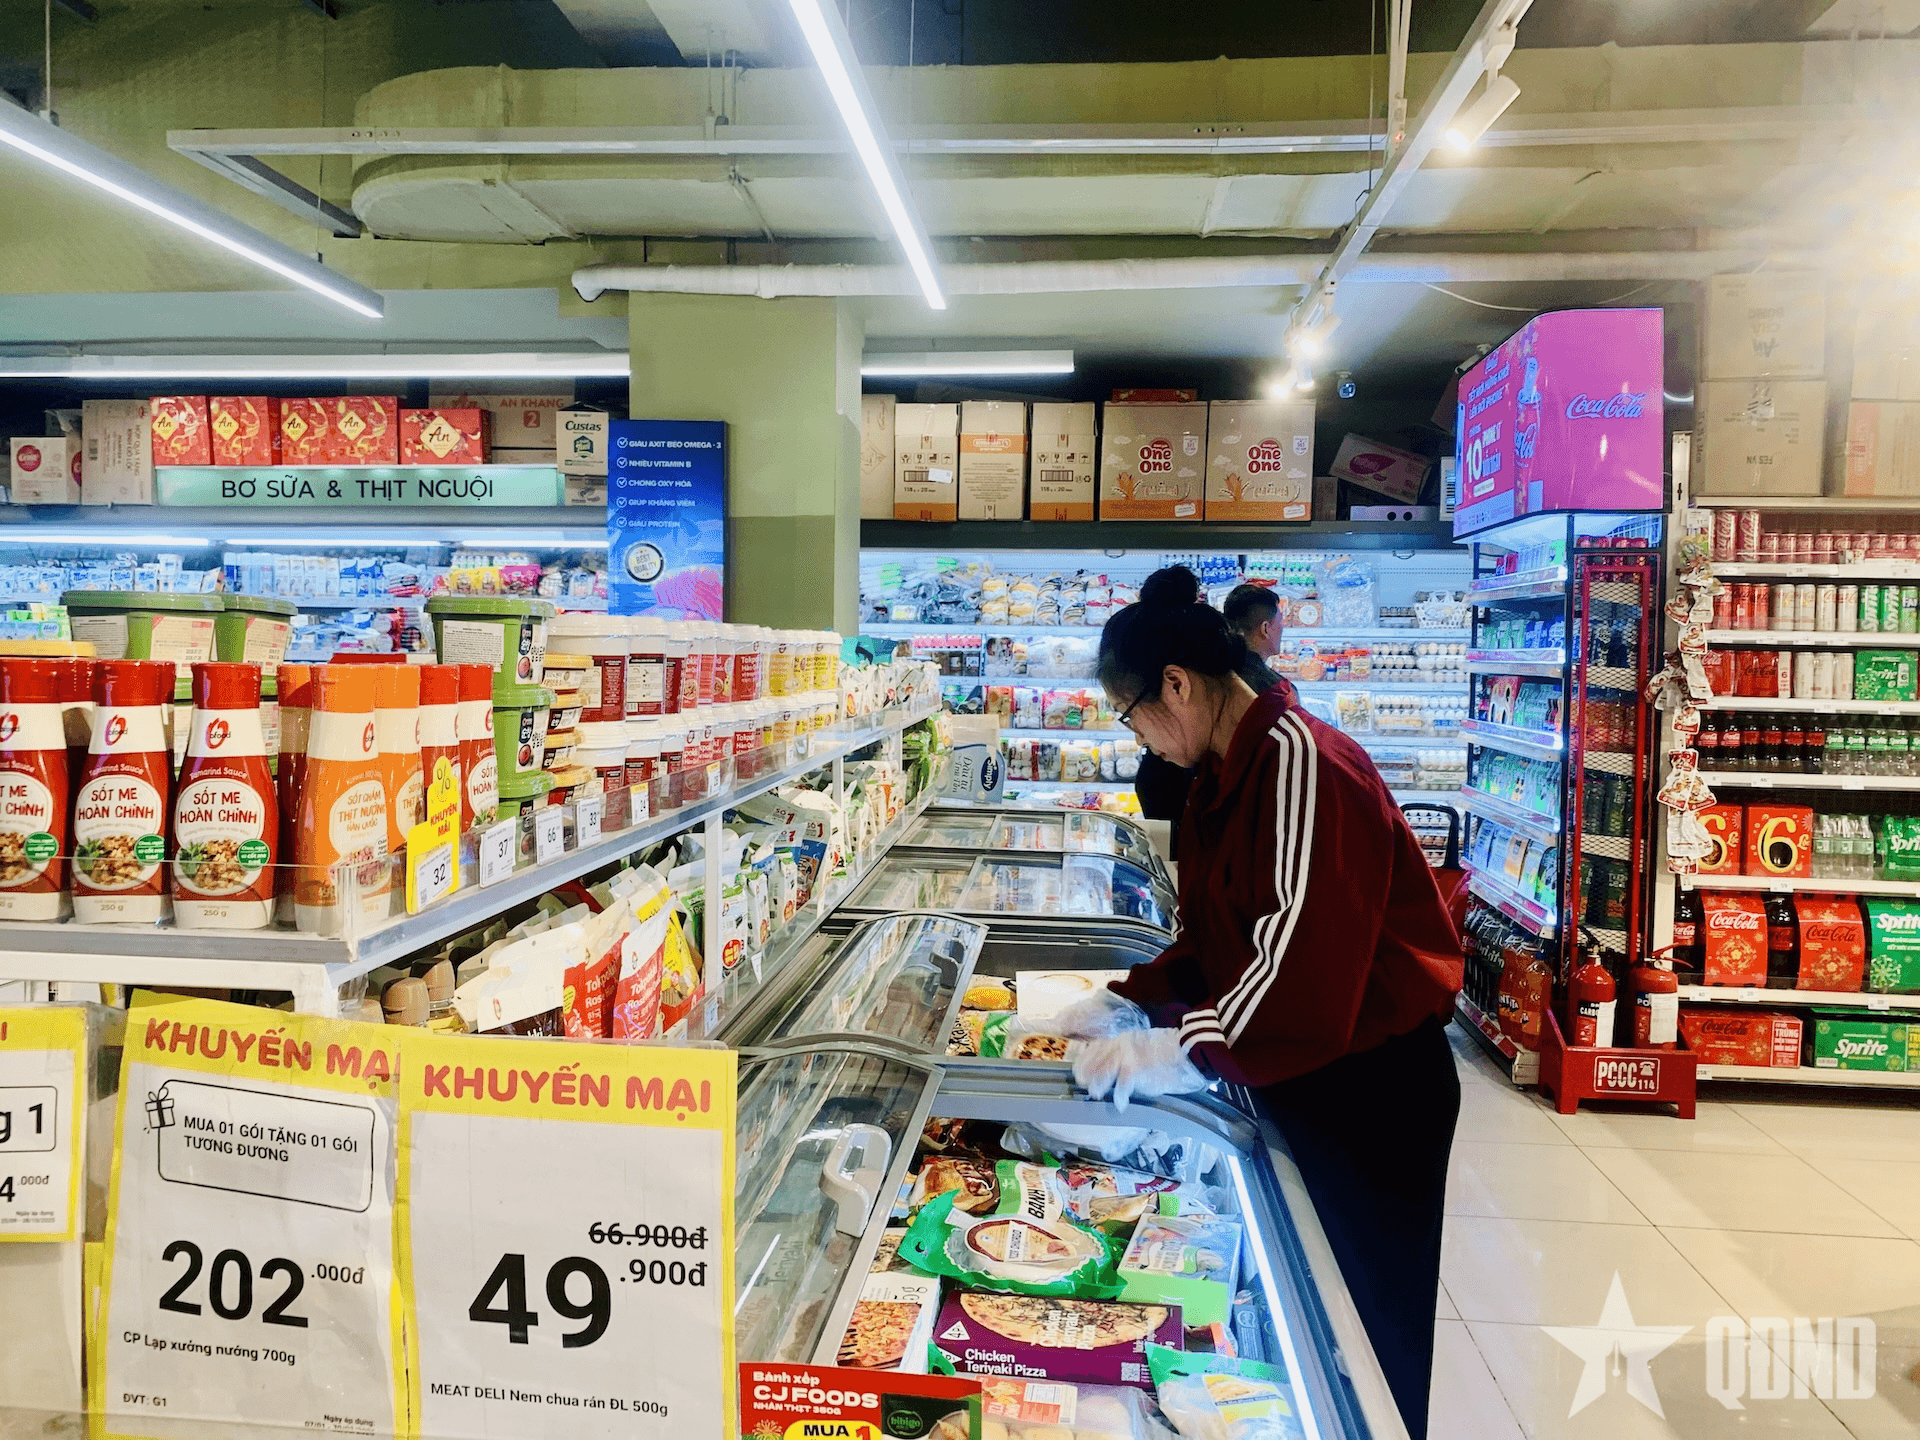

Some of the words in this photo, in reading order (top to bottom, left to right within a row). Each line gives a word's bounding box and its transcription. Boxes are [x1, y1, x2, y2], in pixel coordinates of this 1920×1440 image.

[500, 399, 519, 408] AN
[522, 399, 564, 408] KHANG
[565, 420, 602, 432] Custas
[1140, 447, 1172, 460] One
[1248, 446, 1282, 460] One
[1466, 438, 1482, 484] 10
[1140, 460, 1172, 474] One
[1248, 460, 1282, 474] One
[222, 478, 256, 498] BƠ
[266, 475, 314, 498] SỮA
[326, 480, 342, 498] &
[356, 480, 408, 501] THỊT
[419, 476, 493, 501] NGUỘI
[636, 554, 650, 564] BEST
[634, 562, 657, 574] QUALITY
[120, 762, 144, 775] Sauce
[223, 766, 248, 779] Sauce
[984, 759, 998, 789] Simply
[9, 786, 28, 798] ME
[118, 788, 138, 800] ME
[221, 792, 241, 804] ME
[78, 804, 110, 820] HOÀN
[180, 807, 212, 824] HOÀN
[589, 812, 597, 826] 33
[548, 828, 556, 843] 66
[817, 822, 823, 838] 1
[498, 839, 509, 858] 37
[1758, 816, 1798, 874] 6
[433, 864, 446, 886] 32
[101, 904, 115, 912] 250
[118, 904, 124, 912] g
[204, 909, 218, 917] 250
[1710, 912, 1760, 930] Coca-Cola
[144, 1018, 312, 1071] KHUYẾN
[1834, 1038, 1888, 1058] Sprite
[1598, 1061, 1638, 1088] PCCC
[1638, 1079, 1655, 1090] 114
[422, 1062, 610, 1108] KHUYẾN
[625, 1076, 711, 1122] MẠI
[28, 1103, 42, 1134] 1
[184, 1116, 215, 1133] MUA
[219, 1119, 234, 1135] 01
[240, 1120, 264, 1140] GÓI
[268, 1125, 306, 1147] TẶNG
[312, 1132, 328, 1148] 01
[332, 1134, 358, 1153] GÓI
[184, 1134, 234, 1155] TƯƠNG
[237, 1141, 290, 1163] ĐƯƠNG
[588, 1222, 708, 1250] 66.900đ
[158, 1240, 309, 1328] 202
[311, 1263, 365, 1286] .000đ
[468, 1252, 612, 1349] 49
[620, 1258, 707, 1287] .900đ
[124, 1332, 141, 1345] CP
[144, 1334, 167, 1352] Lạp
[170, 1338, 212, 1357] xưởng
[216, 1344, 258, 1362] nướng
[262, 1348, 296, 1366] 700g
[964, 1348, 1016, 1364] Chicken
[964, 1360, 1012, 1376] Teriyaki
[1014, 1364, 1047, 1378] Pizza
[753, 1371, 791, 1384] Bánh
[154, 1395, 167, 1408] G1
[430, 1382, 470, 1398] MEAT
[474, 1386, 505, 1400] DELI
[510, 1390, 542, 1404] Nem
[546, 1392, 579, 1407] chua
[583, 1394, 606, 1410] rán
[610, 1397, 628, 1411] ĐL
[632, 1400, 668, 1418] 500g
[753, 1384, 788, 1402] CJ
[792, 1388, 878, 1408] FOODS
[753, 1402, 784, 1412] NHÂN
[784, 1404, 811, 1414] THỊT
[803, 1424, 850, 1437] MUA
[890, 1416, 920, 1430] bibigo
